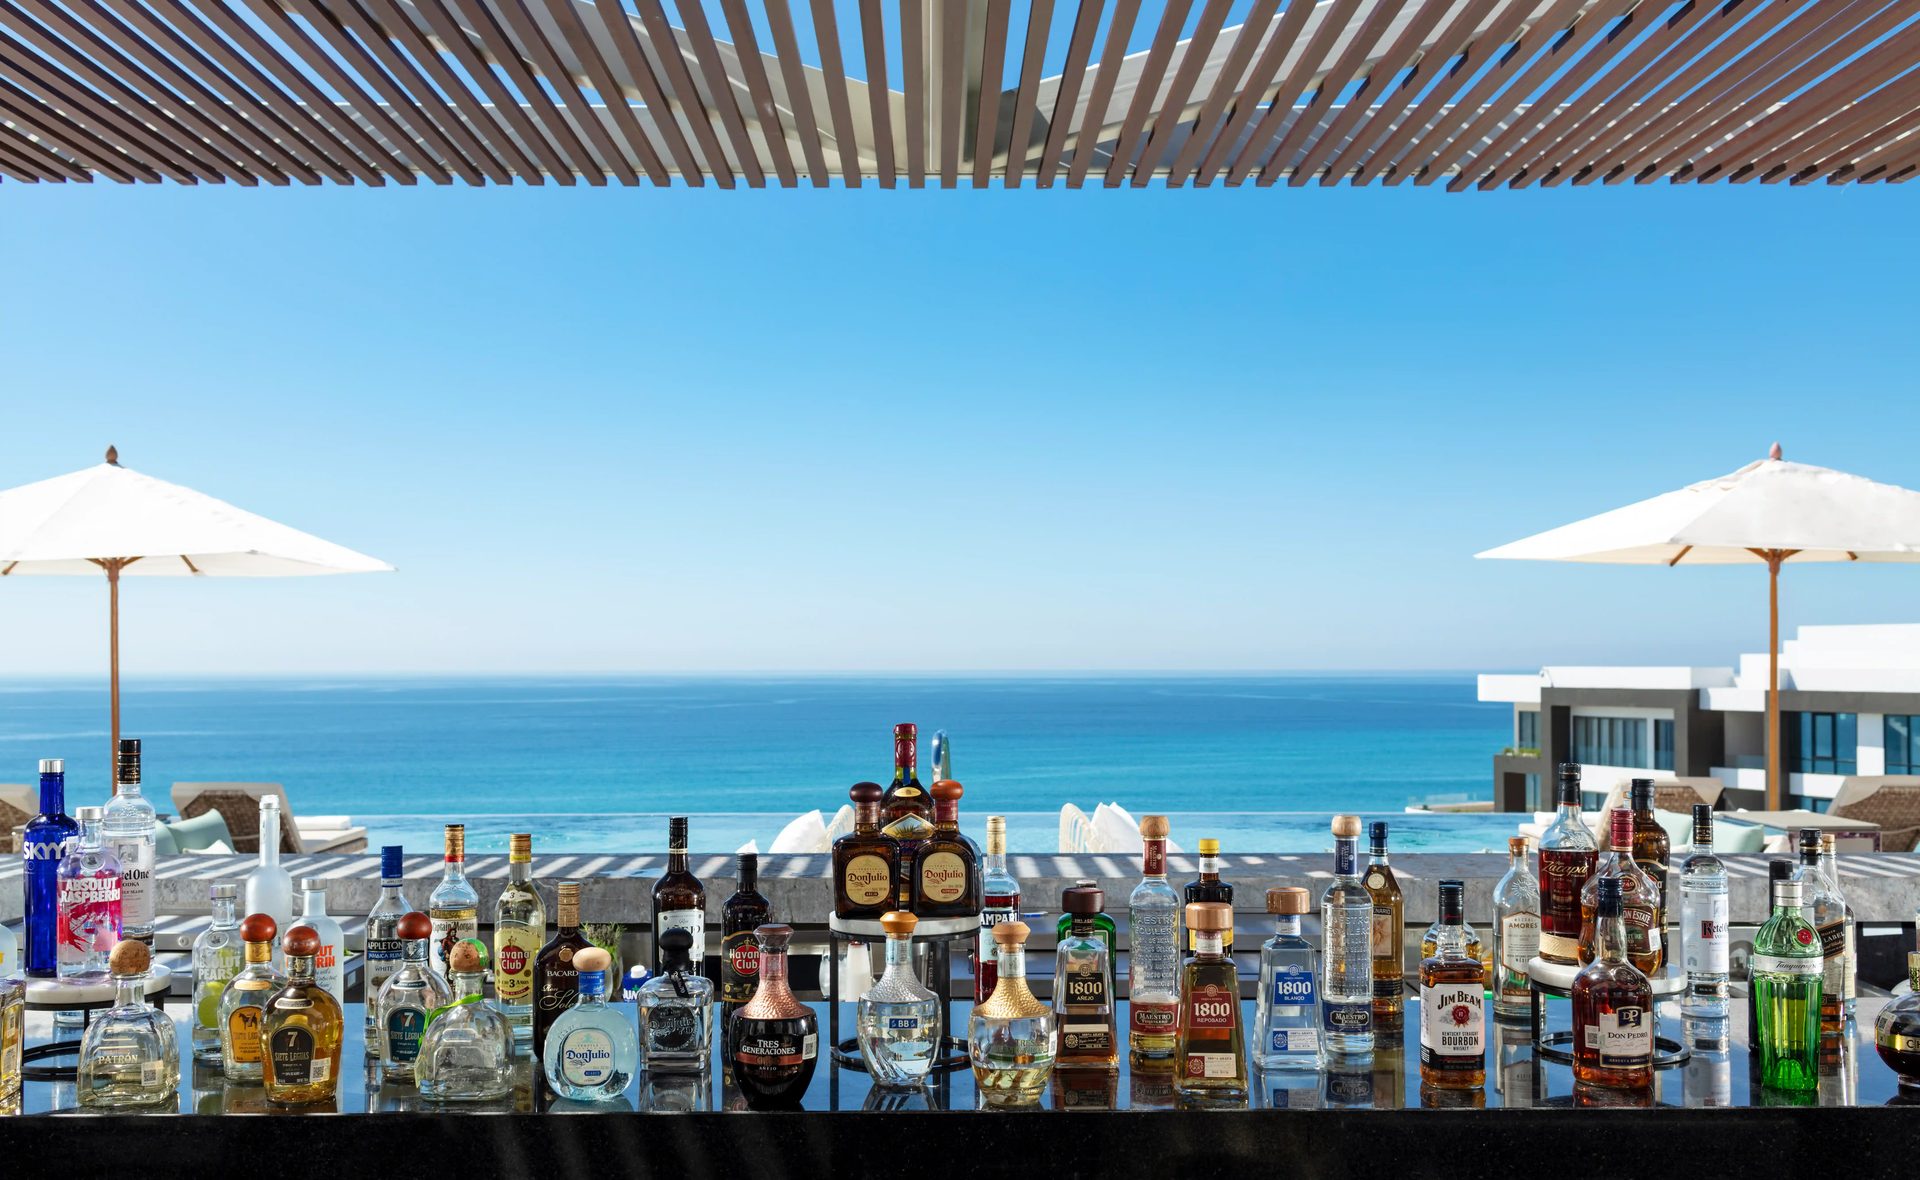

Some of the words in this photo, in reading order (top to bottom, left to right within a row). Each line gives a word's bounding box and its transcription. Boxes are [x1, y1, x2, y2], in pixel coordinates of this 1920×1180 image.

[23, 841, 68, 860] SKYY
[133, 869, 150, 880] One
[65, 876, 118, 891] ABSOLUT
[60, 887, 121, 903] RASPBERRI
[980, 912, 1018, 926] AMPARI
[1632, 910, 1651, 924] ESTATE
[1823, 930, 1846, 943] LABEL
[368, 941, 403, 950] APPLETON
[498, 950, 531, 960] avana
[729, 948, 760, 959] Havan
[501, 959, 522, 970] Club
[736, 959, 758, 969] Club
[1775, 960, 1817, 970] Tanqueray
[198, 968, 234, 980] PEARS
[509, 978, 515, 988] 3
[1068, 981, 1103, 995] 1800
[1277, 981, 1311, 995] 1800
[1437, 993, 1456, 1010] JIM
[1456, 990, 1482, 1010] BEAM
[1193, 1002, 1230, 1017] 1800
[403, 1012, 415, 1027] 7
[1140, 1012, 1171, 1021] MAESTRO
[1335, 1012, 1367, 1021] MAESTRO
[287, 1031, 298, 1048] 7
[404, 1031, 422, 1040] LEGUA
[1607, 1031, 1627, 1039] DON
[1627, 1031, 1648, 1039] PEDRO
[756, 1039, 780, 1048] TRES
[1441, 1036, 1479, 1046] BOURBON
[741, 1044, 796, 1056] GENERACIONES
[98, 1053, 138, 1065] PATRÓN
[274, 1052, 289, 1062] SIETE
